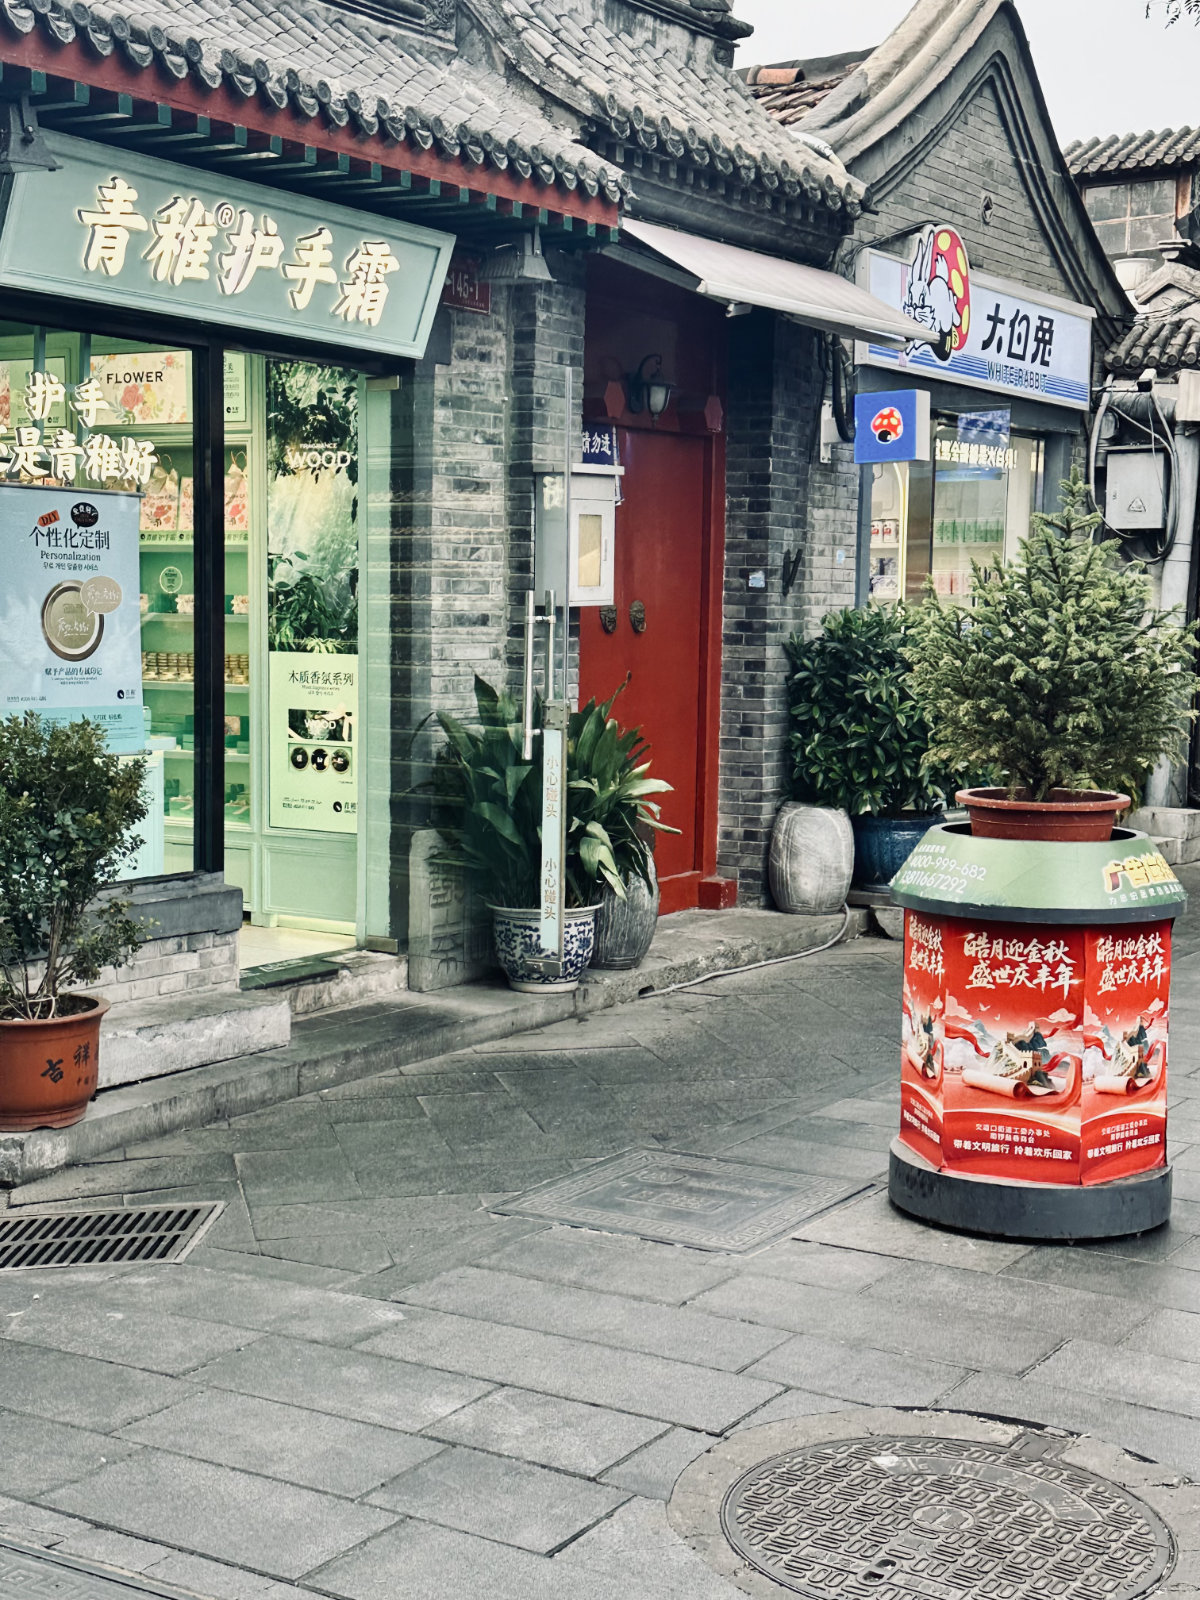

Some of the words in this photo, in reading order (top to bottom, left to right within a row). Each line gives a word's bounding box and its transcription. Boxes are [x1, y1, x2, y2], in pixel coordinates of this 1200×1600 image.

[981, 303, 1055, 367] 大白兔
[106, 371, 164, 384] FLOWER
[987, 361, 1015, 384] WHITE
[1018, 368, 1047, 392] RABBIT
[24, 371, 109, 427] 护手
[287, 450, 351, 469] WOOD
[41, 511, 58, 526] DIY
[29, 526, 110, 550] 个性化定制
[40, 550, 101, 562] Personalization
[288, 670, 354, 686] 木质香氛系列
[963, 932, 1077, 964] 皓月迎金秋
[1096, 933, 1165, 962] 皓月迎金秋
[965, 960, 1077, 999] 盛世庆丰年
[1096, 956, 1166, 995] 盛世庆丰年
[953, 1139, 1010, 1154] 带着文明旅行
[1014, 1146, 1073, 1160] 拎着欢乐回家
